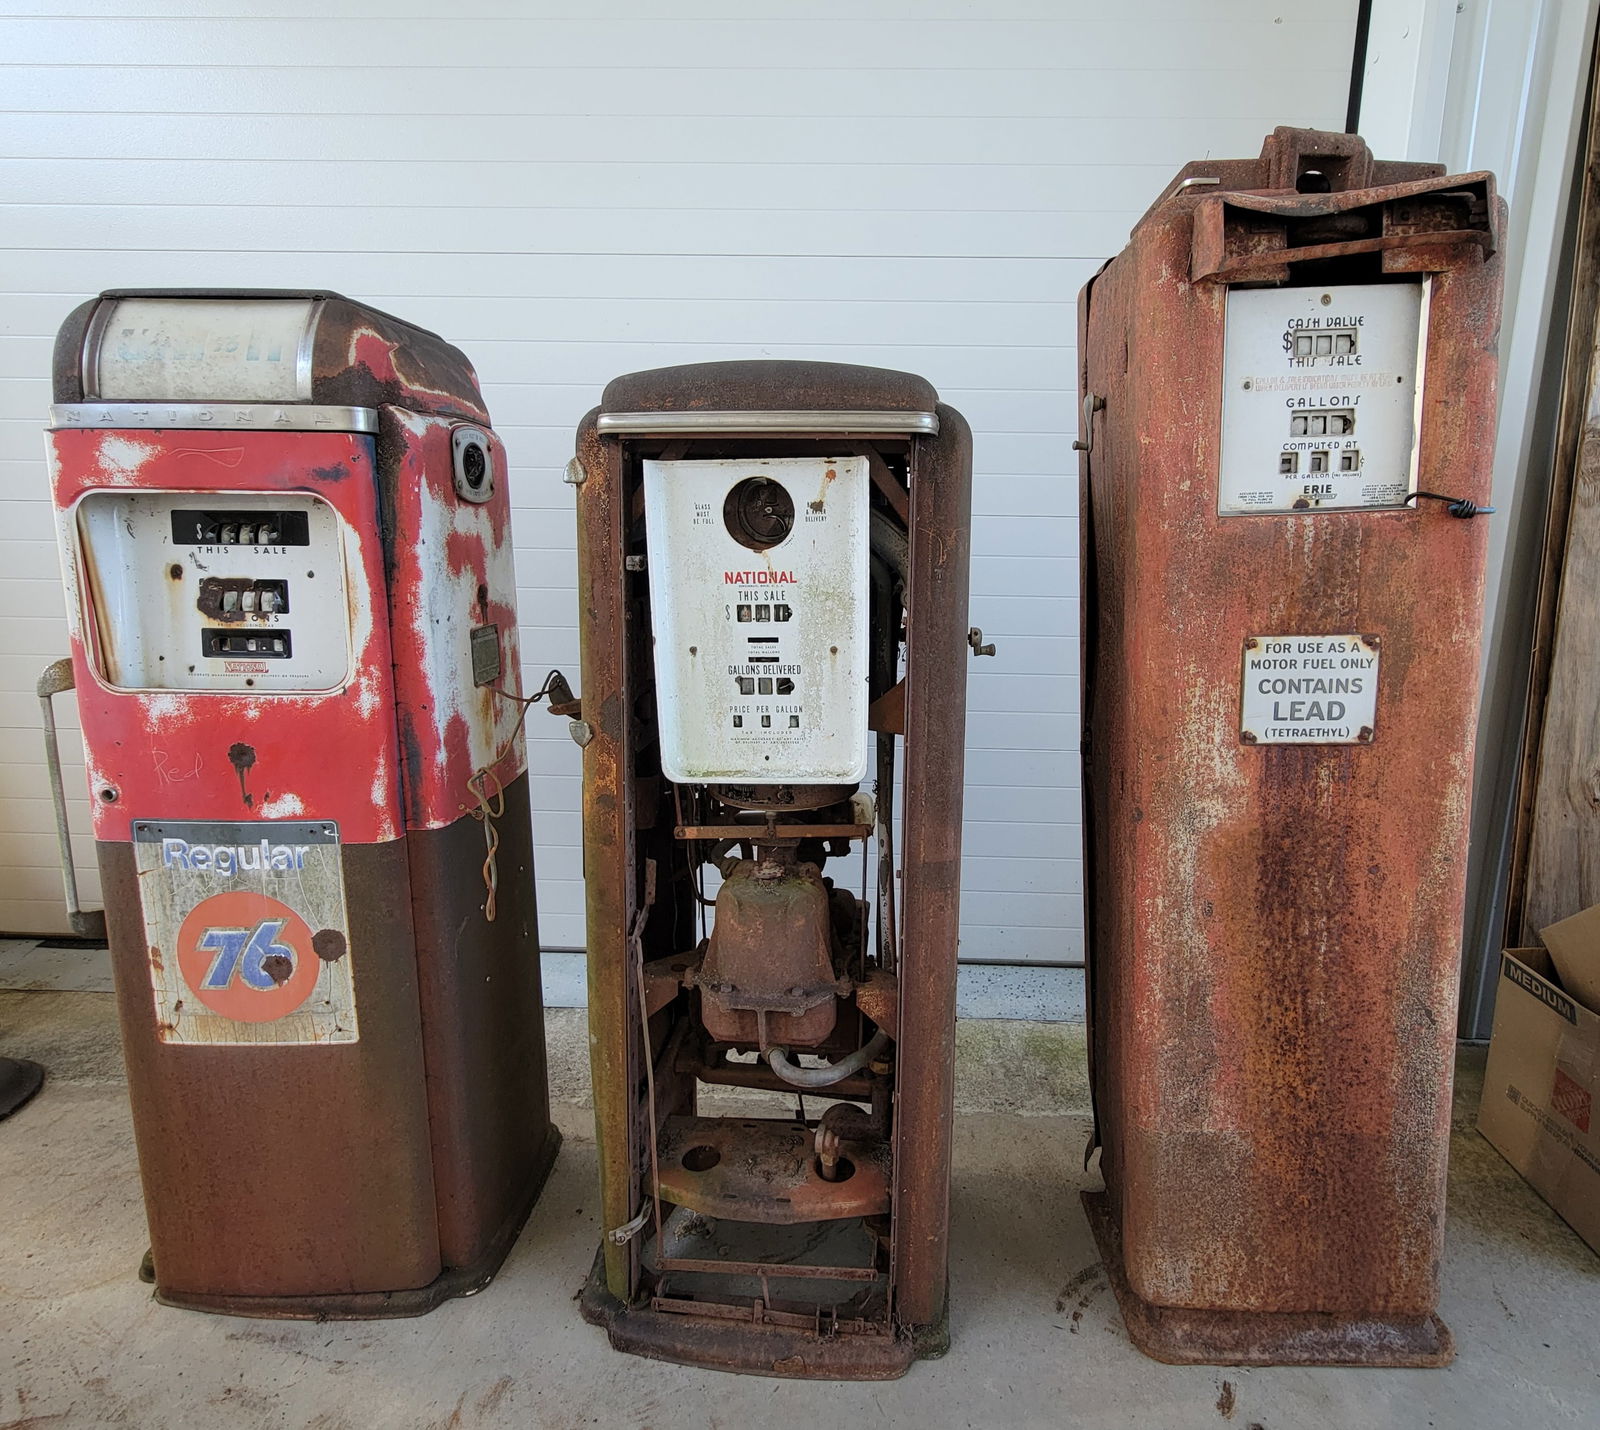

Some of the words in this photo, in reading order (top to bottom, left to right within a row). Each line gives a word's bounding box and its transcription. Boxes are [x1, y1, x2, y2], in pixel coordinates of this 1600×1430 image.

[1287, 317, 1320, 329] CASH
[1326, 315, 1364, 328] VALUE
[1282, 330, 1293, 353] $
[1288, 357, 1317, 368] THIS
[1328, 355, 1362, 367] SALE
[1286, 395, 1361, 408] GALLONS
[65, 409, 335, 425] NATIONAL
[1283, 441, 1340, 451] COMPUTED
[1345, 440, 1358, 450] AT
[1301, 472, 1330, 480] GALLON
[1303, 484, 1333, 495] ERIE
[197, 546, 229, 554] THIS
[253, 546, 287, 555] SALE
[724, 571, 798, 584] NATIONAL
[738, 590, 759, 601] THIS
[764, 590, 786, 601] SALE
[1265, 643, 1291, 654] FOR
[1298, 642, 1323, 653] USE
[1328, 642, 1346, 653] AS
[1351, 642, 1360, 653] A
[728, 665, 760, 675] GALLONS
[763, 664, 802, 675] DELIVERED
[1251, 659, 1297, 670] MOTOR
[1303, 658, 1336, 669] FUEL
[1340, 658, 1374, 669] ONLY
[1258, 678, 1363, 694] CONTAINS
[729, 705, 750, 713] PRICE
[756, 705, 769, 713] PER
[775, 705, 803, 713] GALLON
[1273, 701, 1346, 721] LEAD
[1264, 726, 1350, 738] (TETRAETHYL)
[151, 748, 203, 786] Red
[162, 838, 310, 876] Regular
[198, 919, 297, 990] 76
[1510, 963, 1571, 1019] MEDIUM
